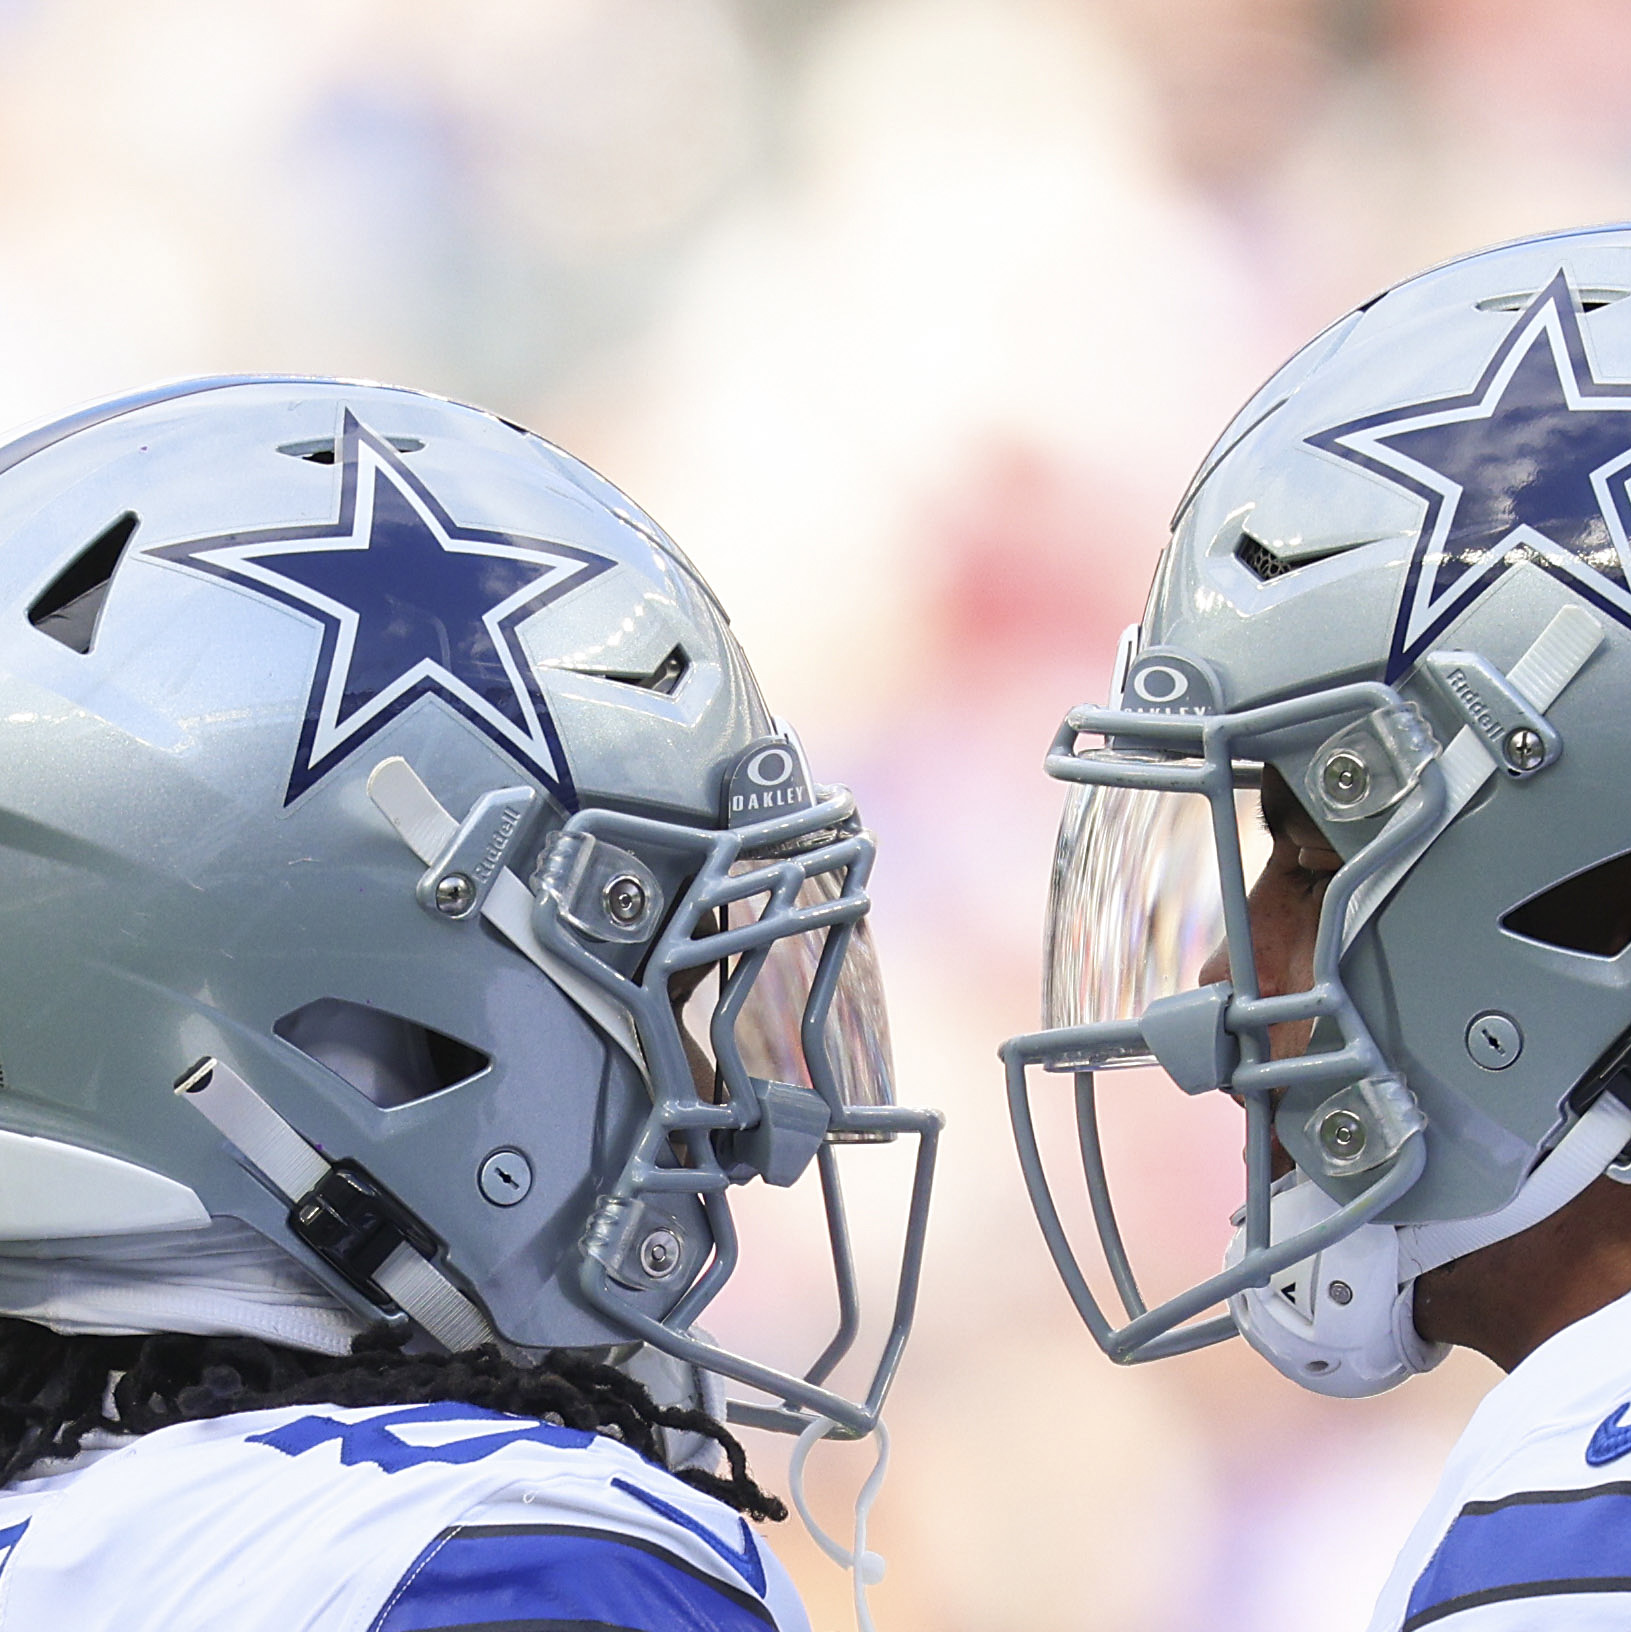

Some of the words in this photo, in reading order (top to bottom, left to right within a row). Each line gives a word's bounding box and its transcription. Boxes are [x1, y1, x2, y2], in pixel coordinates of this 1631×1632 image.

[1446, 667, 1506, 742] Riddell
[732, 785, 804, 812] OAKLEY
[471, 804, 522, 884] Riddell
